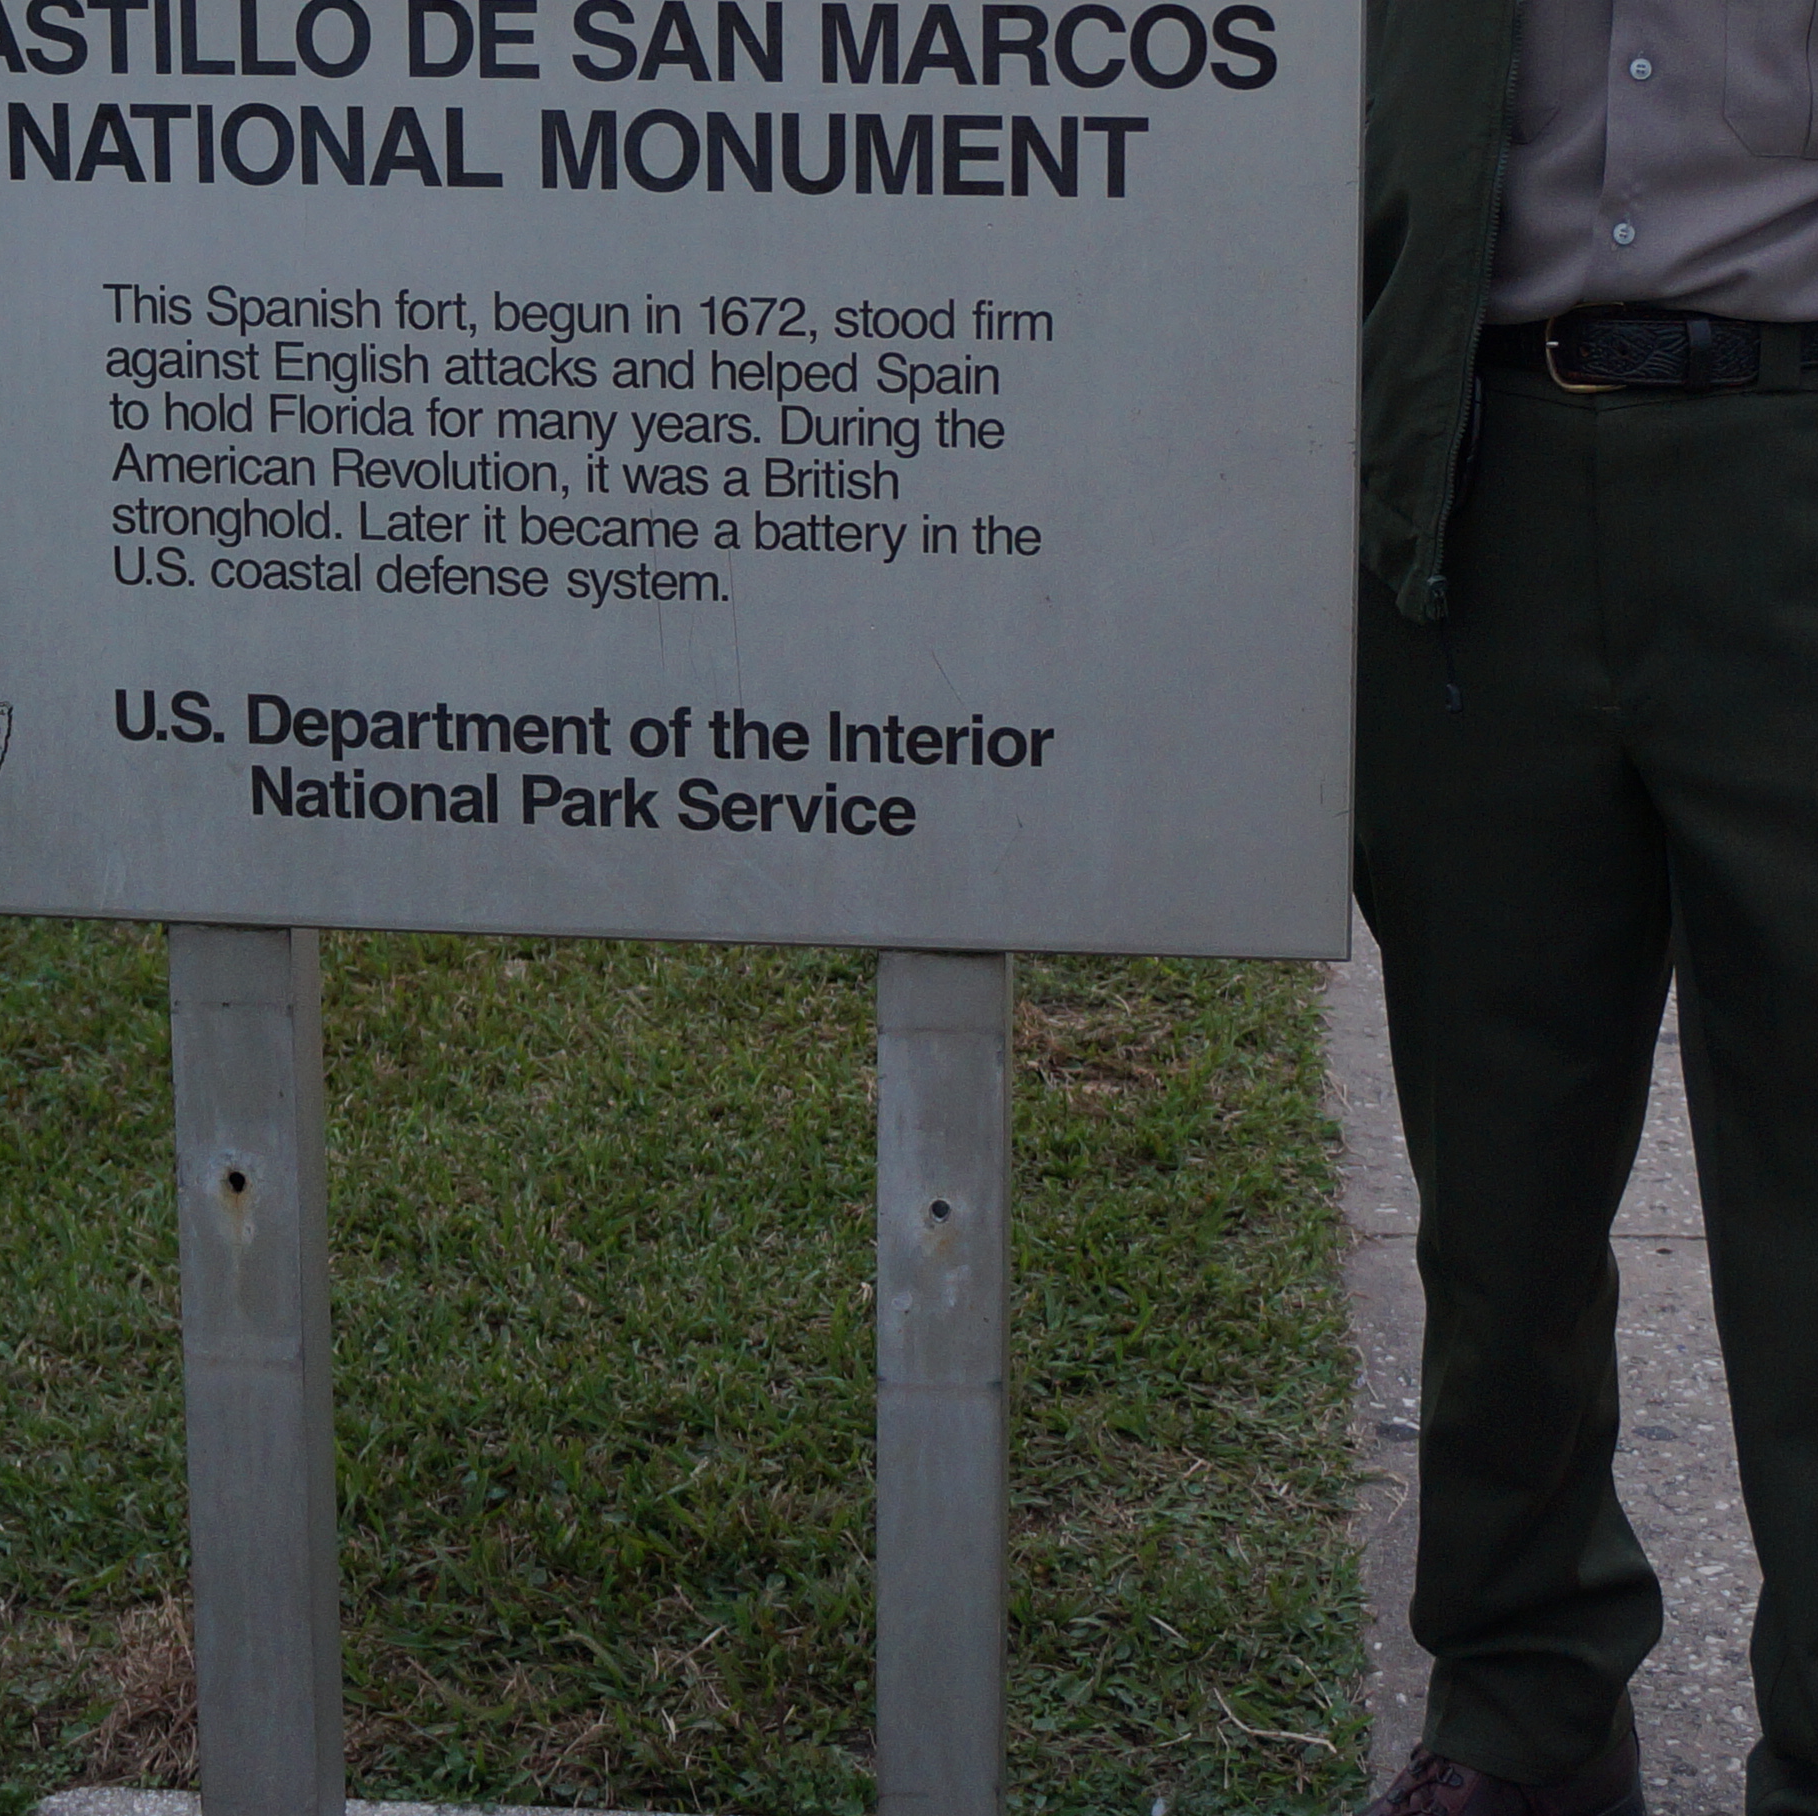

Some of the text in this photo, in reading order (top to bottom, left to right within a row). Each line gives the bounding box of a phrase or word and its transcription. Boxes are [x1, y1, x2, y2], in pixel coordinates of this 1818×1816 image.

[821, 2, 1278, 91] MARCOS
[7, 101, 1150, 198] NATIONAL MONUMENT
[102, 283, 1053, 345] This Spanish fort, begun in 1672, stood firm
[106, 340, 999, 405] against English attacks and helped Spain
[109, 391, 1005, 459] to hold Florida for many years. During the
[111, 442, 899, 500] American Revolution, it was a British
[112, 497, 1042, 564] stronghold. Later it became a battery in the
[113, 545, 729, 610] U.S. coastal defense system.
[114, 688, 1055, 768] U.S. Department of the Interior
[251, 764, 917, 837] National Park Service
